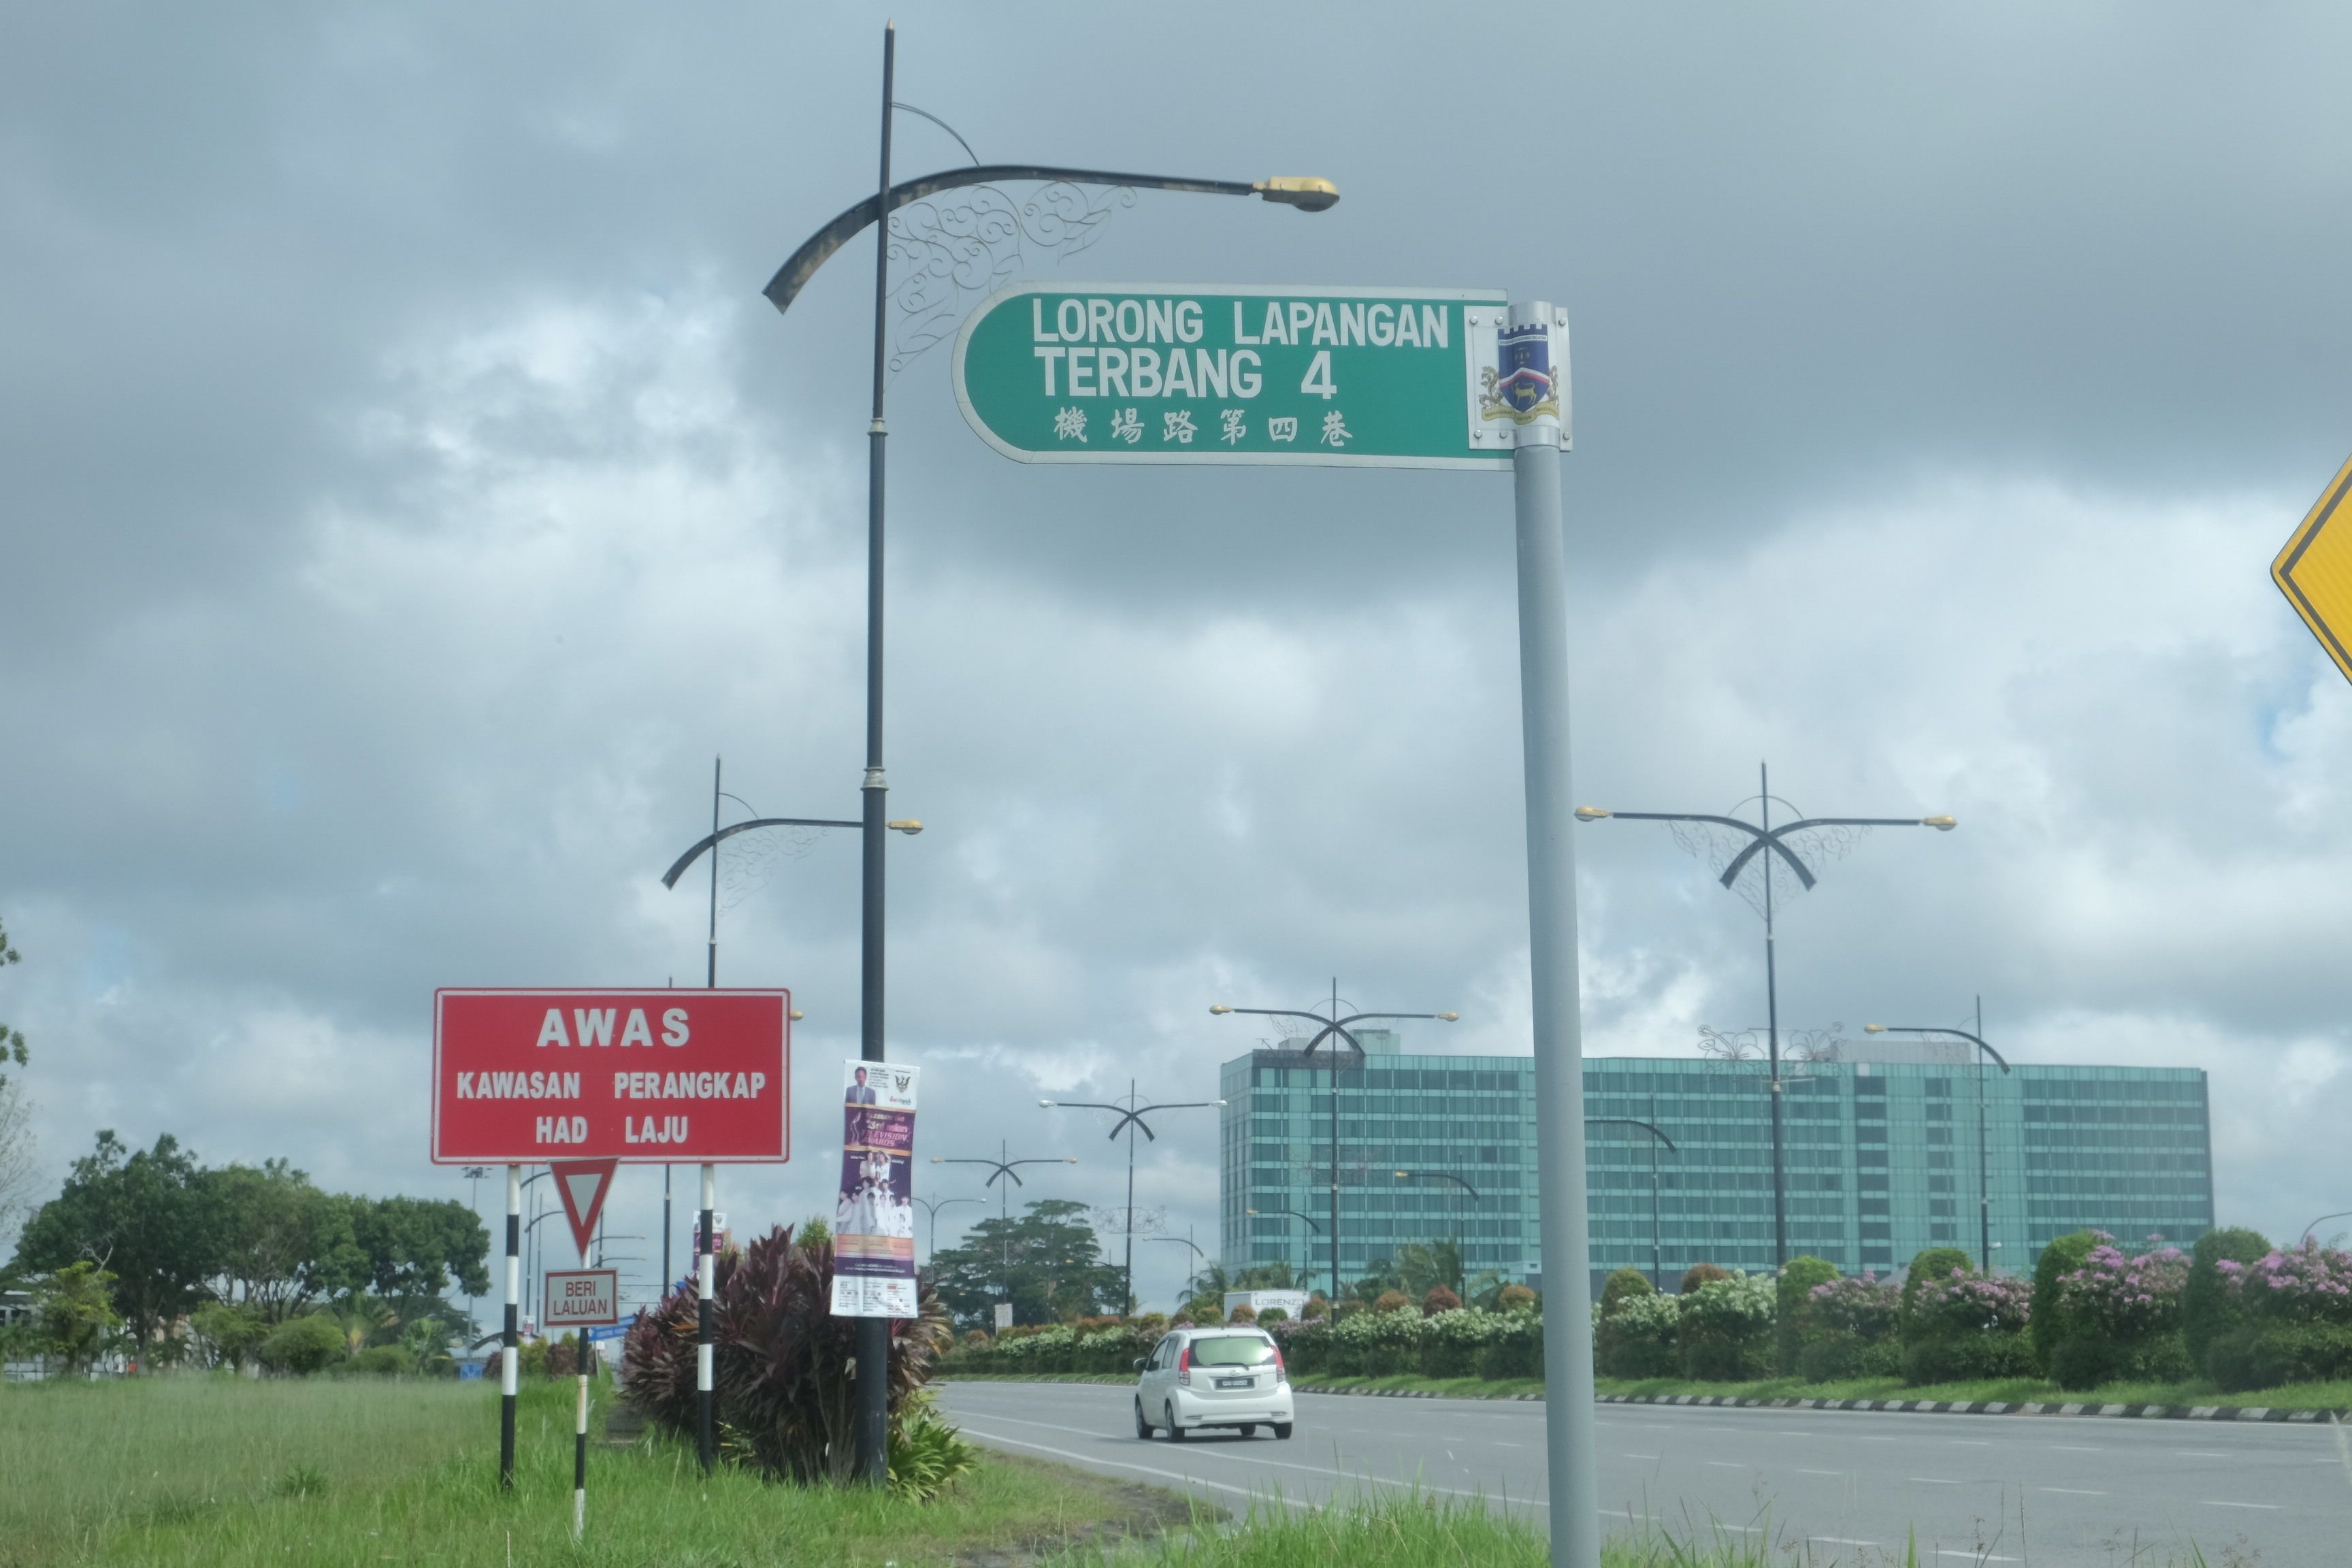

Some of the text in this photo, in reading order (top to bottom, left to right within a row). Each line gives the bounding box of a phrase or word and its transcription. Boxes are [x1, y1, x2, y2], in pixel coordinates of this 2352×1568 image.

[1033, 298, 1449, 348] LORONG LAPANGAN
[1034, 346, 1337, 399] TERBANG 4
[1054, 406, 1352, 446] 機場路第四巷
[537, 1009, 689, 1047] AWAS
[457, 1072, 766, 1098] KAWASAN PERANGKAP
[536, 1116, 688, 1143] HAD LAJU
[566, 1281, 596, 1298] BERI
[553, 1298, 608, 1316] LALUAN
